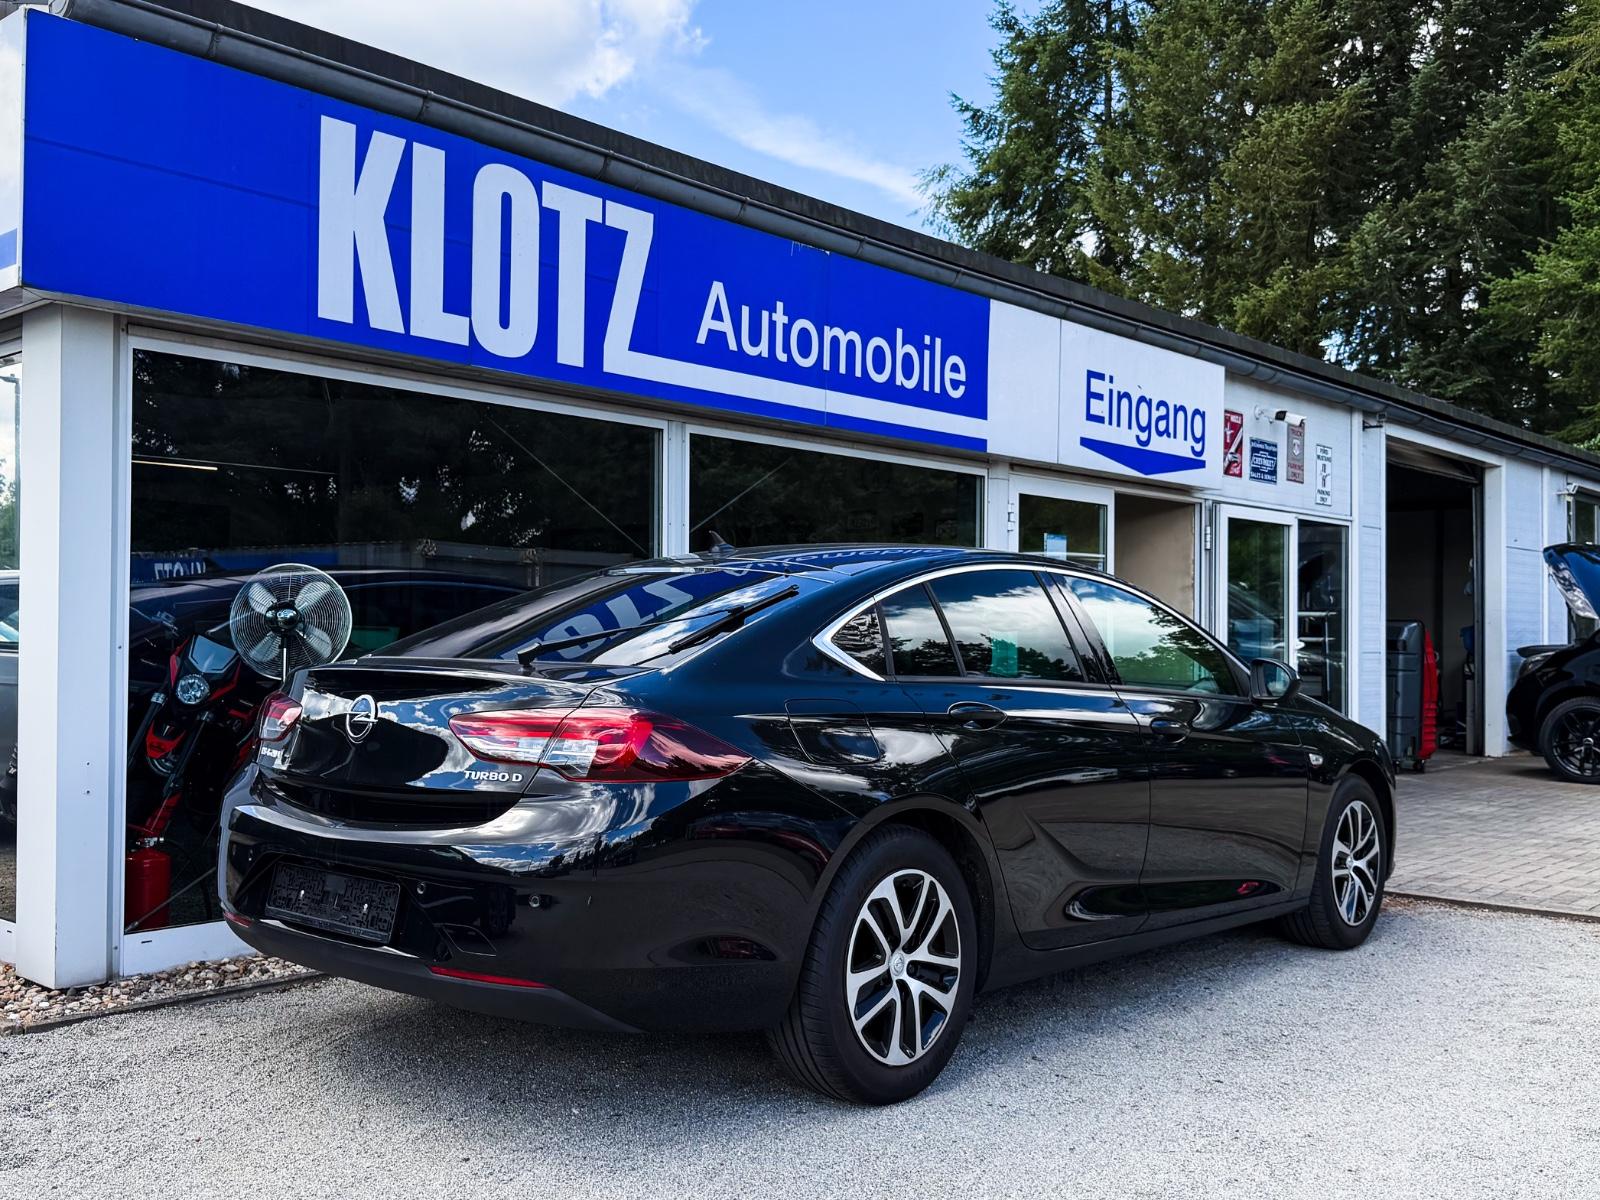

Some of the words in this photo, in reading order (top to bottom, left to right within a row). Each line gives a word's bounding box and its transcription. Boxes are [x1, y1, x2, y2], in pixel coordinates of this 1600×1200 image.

[319, 115, 653, 374] KLOTZ
[696, 281, 966, 399] Automobile
[1086, 369, 1206, 457] Eingang
[464, 770, 509, 782] TURBO
[512, 773, 522, 782] D
